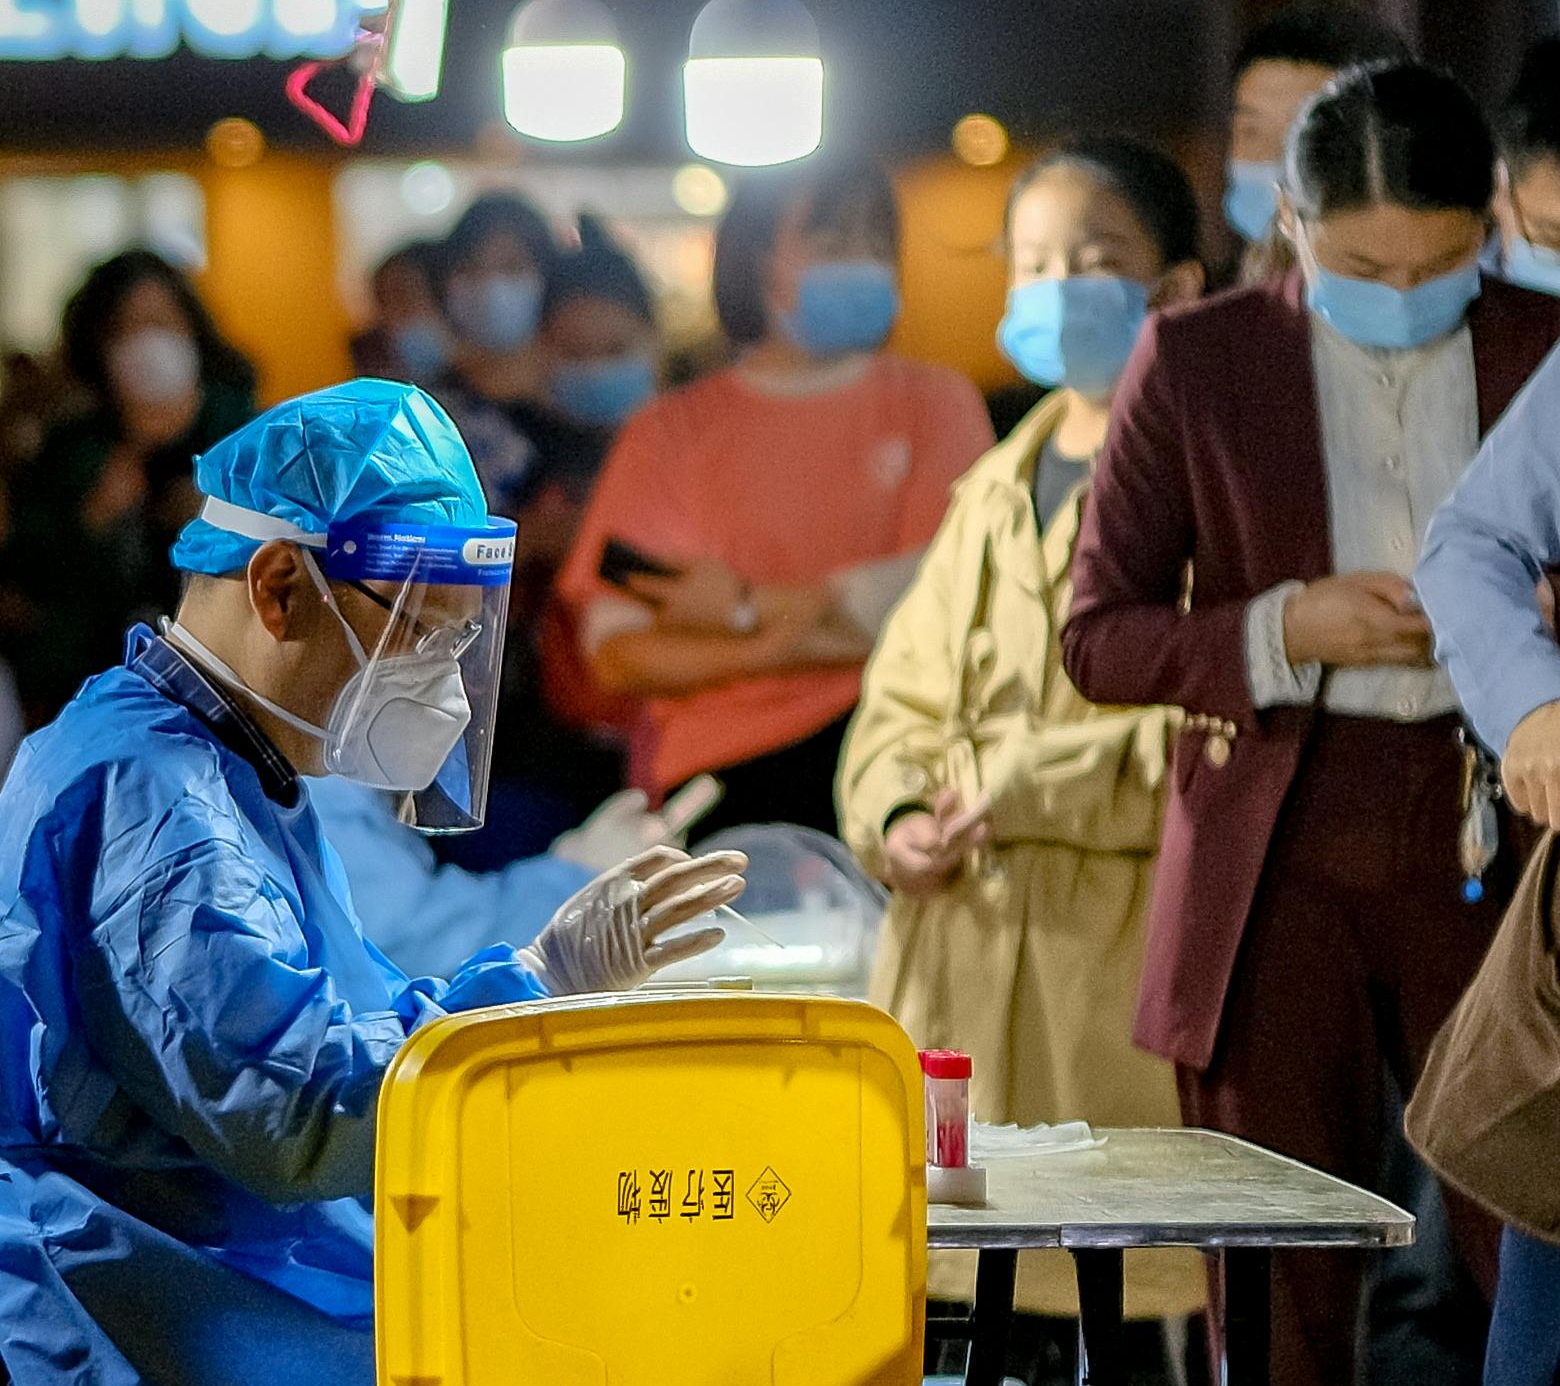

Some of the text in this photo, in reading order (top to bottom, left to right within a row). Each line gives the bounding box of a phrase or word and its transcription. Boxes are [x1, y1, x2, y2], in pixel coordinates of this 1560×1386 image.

[476, 543, 507, 560] Face
[617, 1169, 735, 1225] 医疗废物
